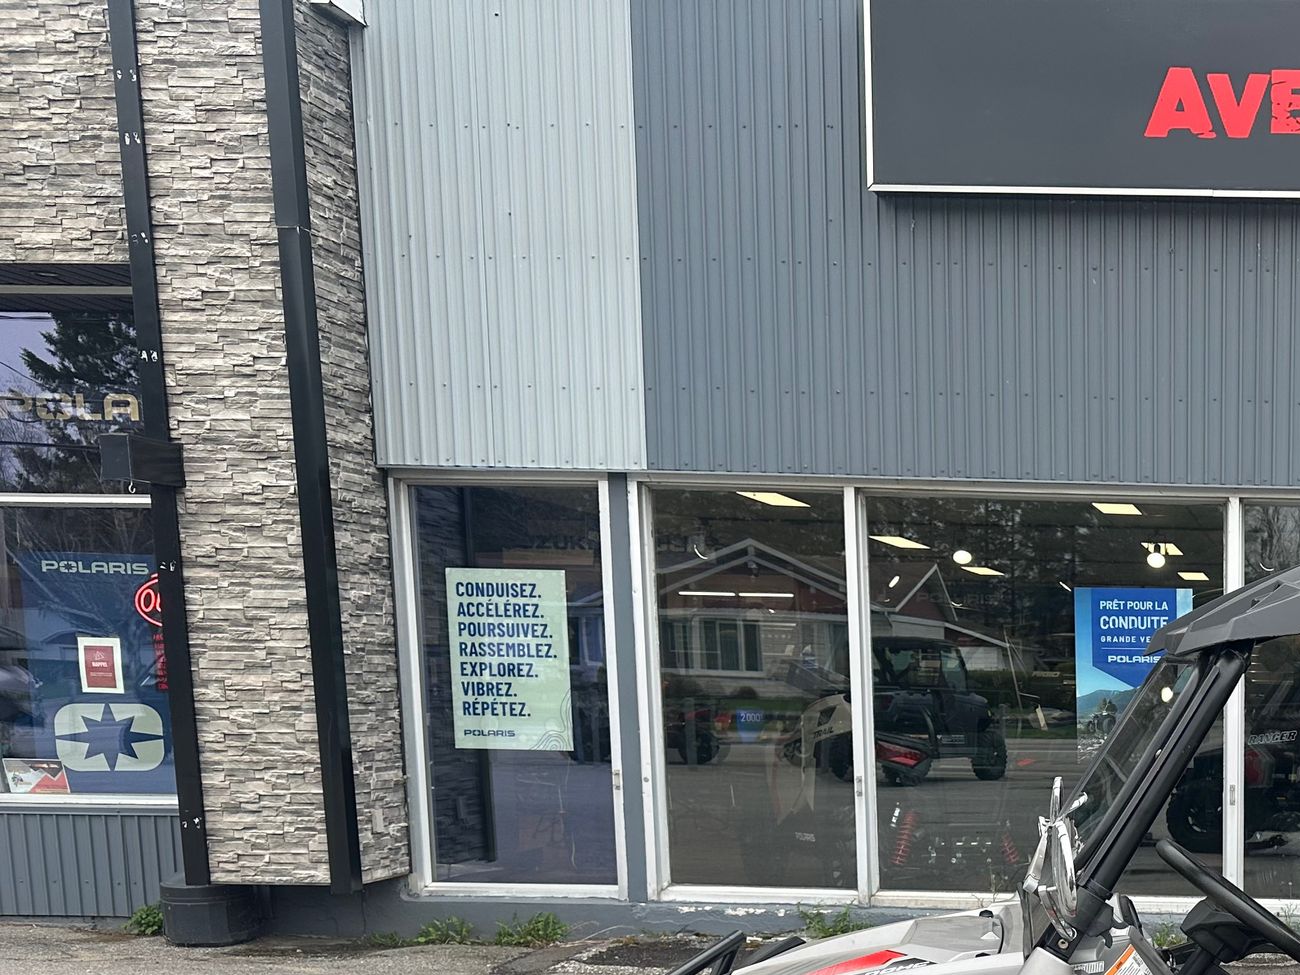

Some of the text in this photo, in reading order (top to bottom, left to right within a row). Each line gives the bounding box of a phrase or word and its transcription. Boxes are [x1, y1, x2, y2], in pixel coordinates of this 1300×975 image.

[41, 560, 149, 575] POLARIS
[455, 582, 542, 598] CONDUISEZ.
[457, 599, 544, 618] ACCÉLÉREZ.
[1100, 599, 1169, 611] PRÊT POUR LA
[458, 621, 553, 639] POURSUIVEZ.
[1100, 616, 1169, 630] CONDUITE
[459, 642, 557, 659] RASSEMBLEZ.
[1108, 655, 1162, 663] POLARIS
[460, 662, 539, 678] EXPLOREZ.
[461, 681, 517, 697] VIBREZ.
[462, 698, 531, 717] RÉPÉTEZ.
[464, 729, 516, 737] POLARIS
[1248, 730, 1297, 745] RANGER
